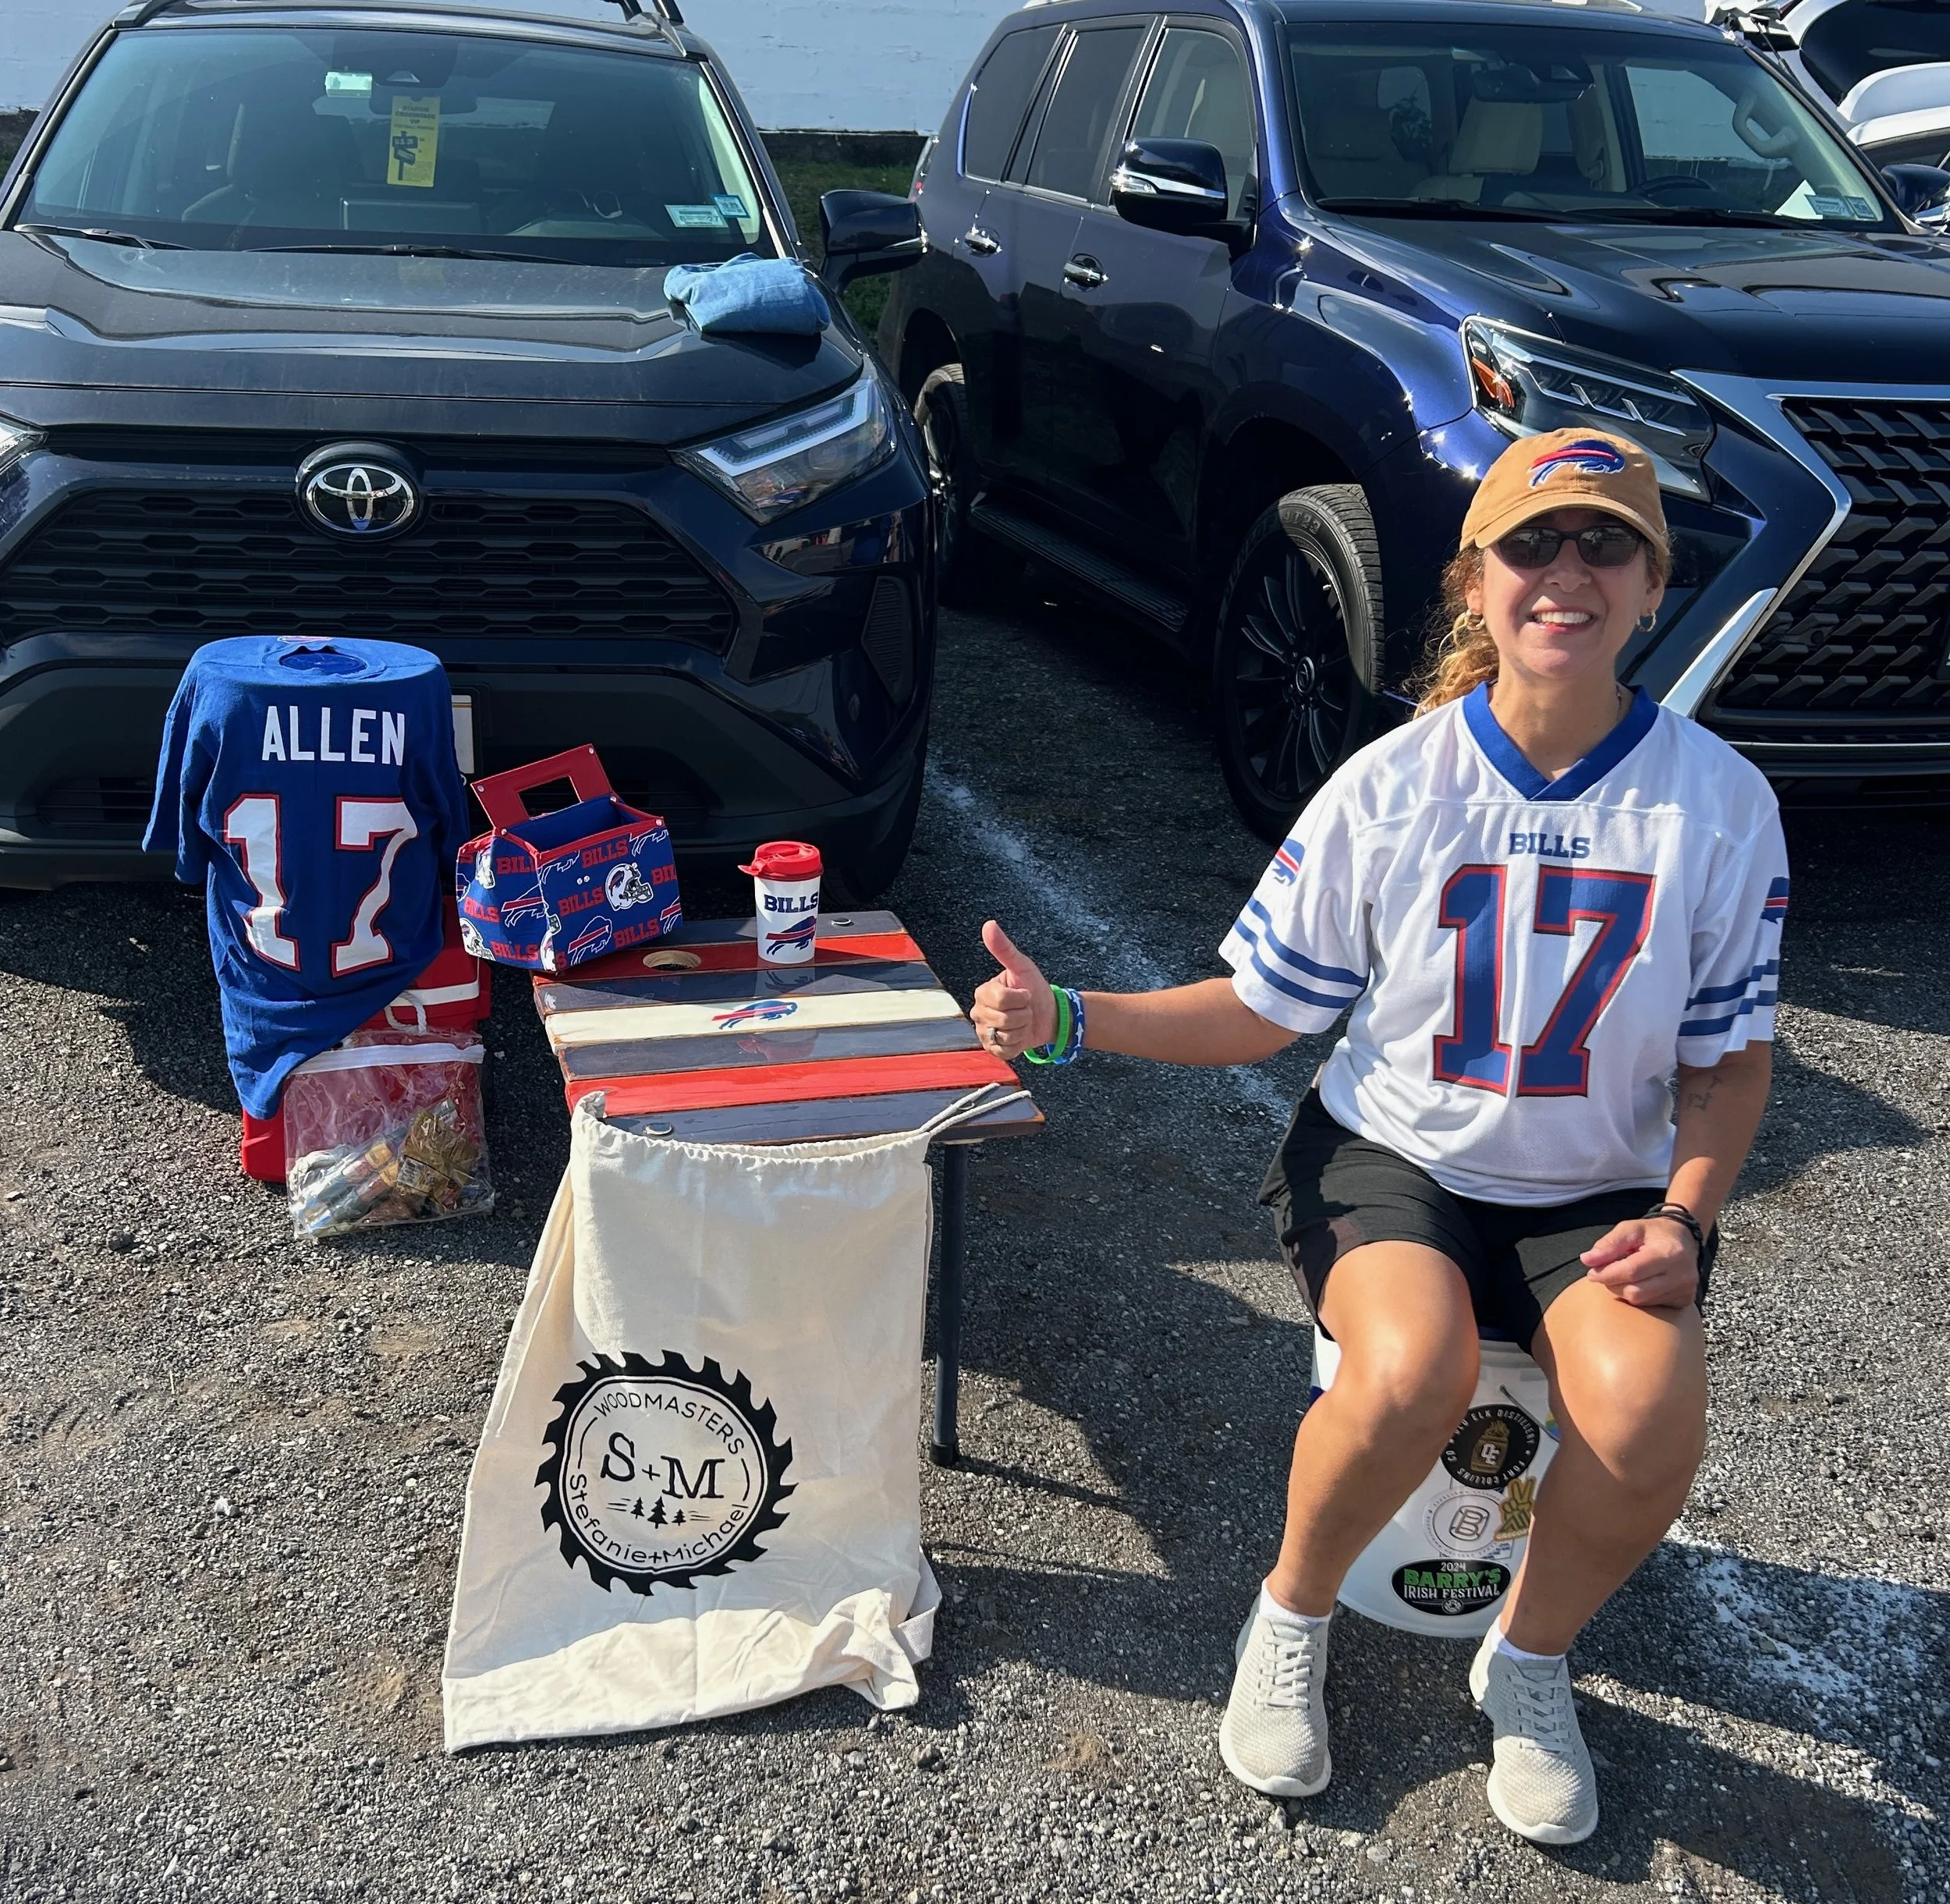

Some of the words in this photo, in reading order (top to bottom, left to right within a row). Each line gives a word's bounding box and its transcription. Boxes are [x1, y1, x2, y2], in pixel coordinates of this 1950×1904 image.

[261, 704, 405, 766] ALLEN
[582, 839, 629, 869] BILLS
[1509, 832, 1590, 860] BILLS
[222, 792, 420, 979] 17
[463, 897, 501, 924] BILLS
[558, 885, 606, 917] BILLS
[763, 892, 819, 913] BILLS
[613, 917, 661, 948] BILLS
[491, 941, 539, 962] BILLS
[1433, 863, 1658, 1098] 17
[594, 1392, 745, 1455] WOODMASTERS
[1470, 1409, 1492, 1421] ELK
[1457, 1467, 1499, 1485] COLLINS
[1502, 1460, 1526, 1480] FORT
[1404, 1568, 1502, 1588] BARRY'S
[1441, 1562, 1466, 1572] 2024
[1404, 1584, 1438, 1599] IRISH
[1443, 1583, 1501, 1599] FESTIVAL
